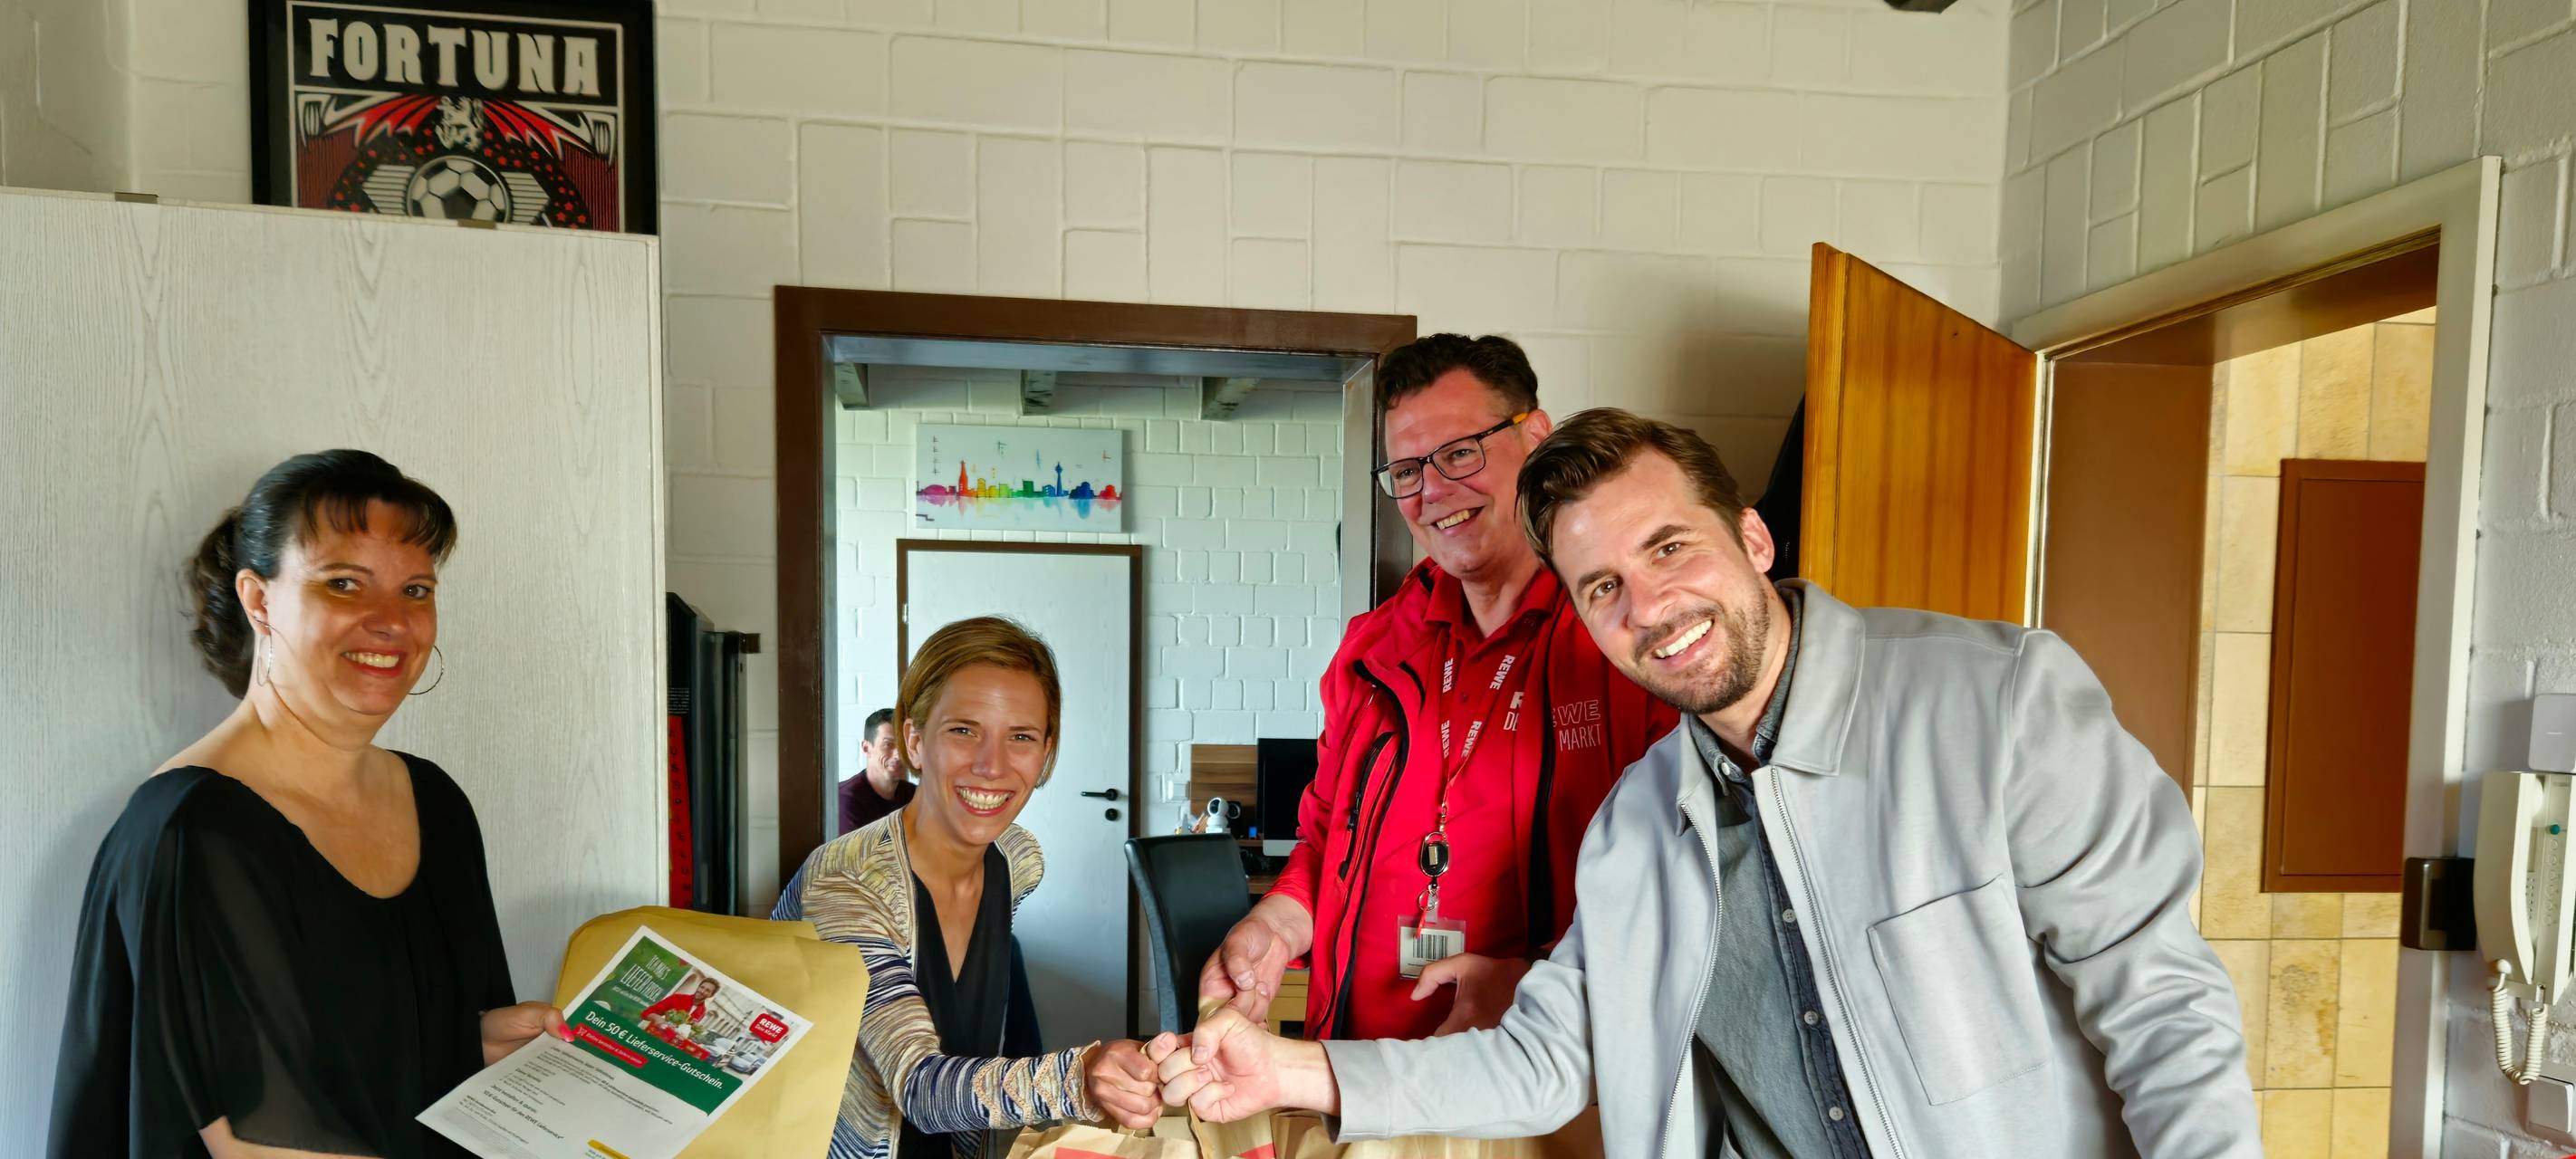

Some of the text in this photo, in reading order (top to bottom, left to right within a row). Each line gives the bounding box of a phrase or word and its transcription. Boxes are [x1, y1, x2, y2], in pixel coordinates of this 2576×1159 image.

[308, 18, 601, 96] FORTUNA
[1443, 658, 1454, 694] REWE
[1489, 655, 1515, 690] REWE
[1461, 721, 1483, 758] REWE
[1559, 723, 1600, 752] MARKT
[759, 1018, 783, 1034] REWE
[584, 1011, 606, 1030] Dein
[626, 1034, 724, 1089] Lieferservice-Gutschein.
